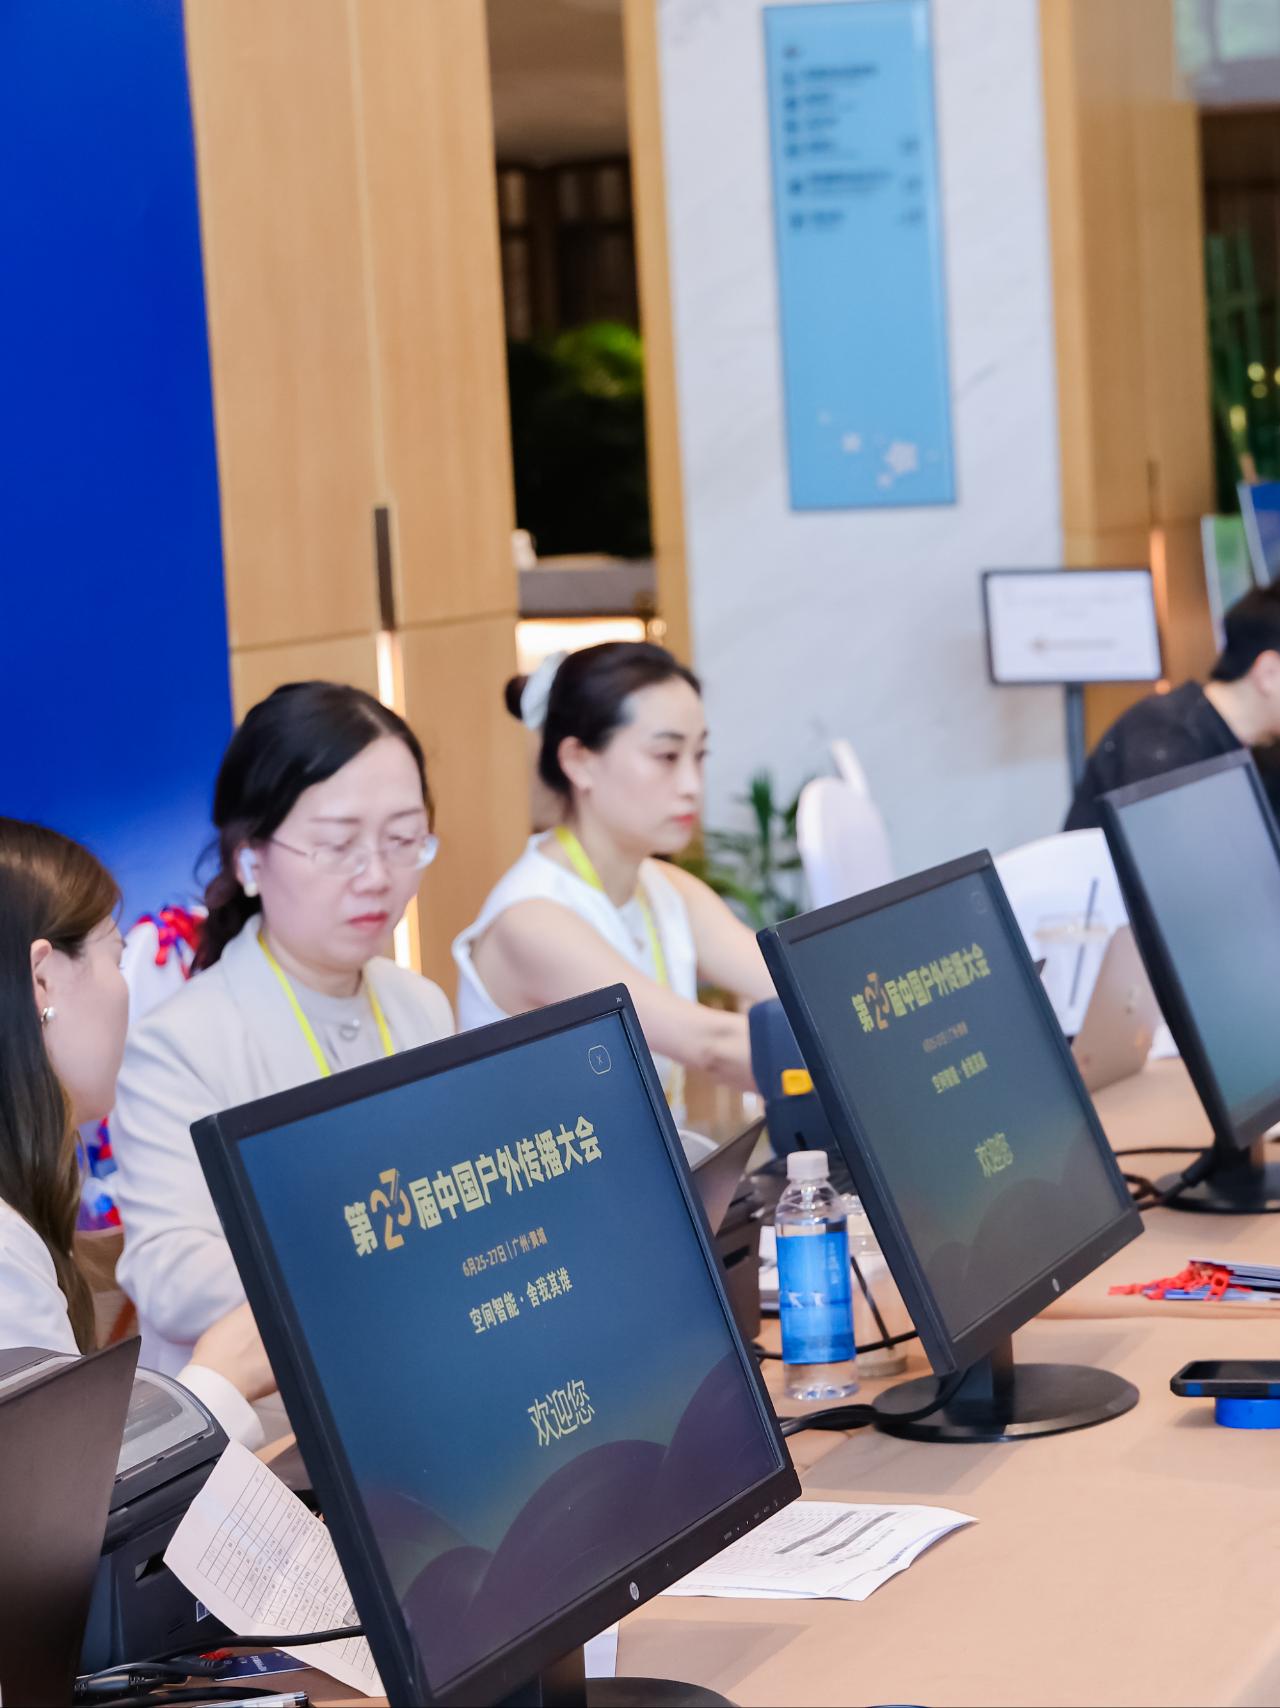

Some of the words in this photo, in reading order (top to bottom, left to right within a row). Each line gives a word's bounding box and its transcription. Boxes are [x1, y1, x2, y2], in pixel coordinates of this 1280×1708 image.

[344, 1115, 602, 1257] 第23届中国户外传播大会
[527, 1379, 596, 1447] 欢迎您
